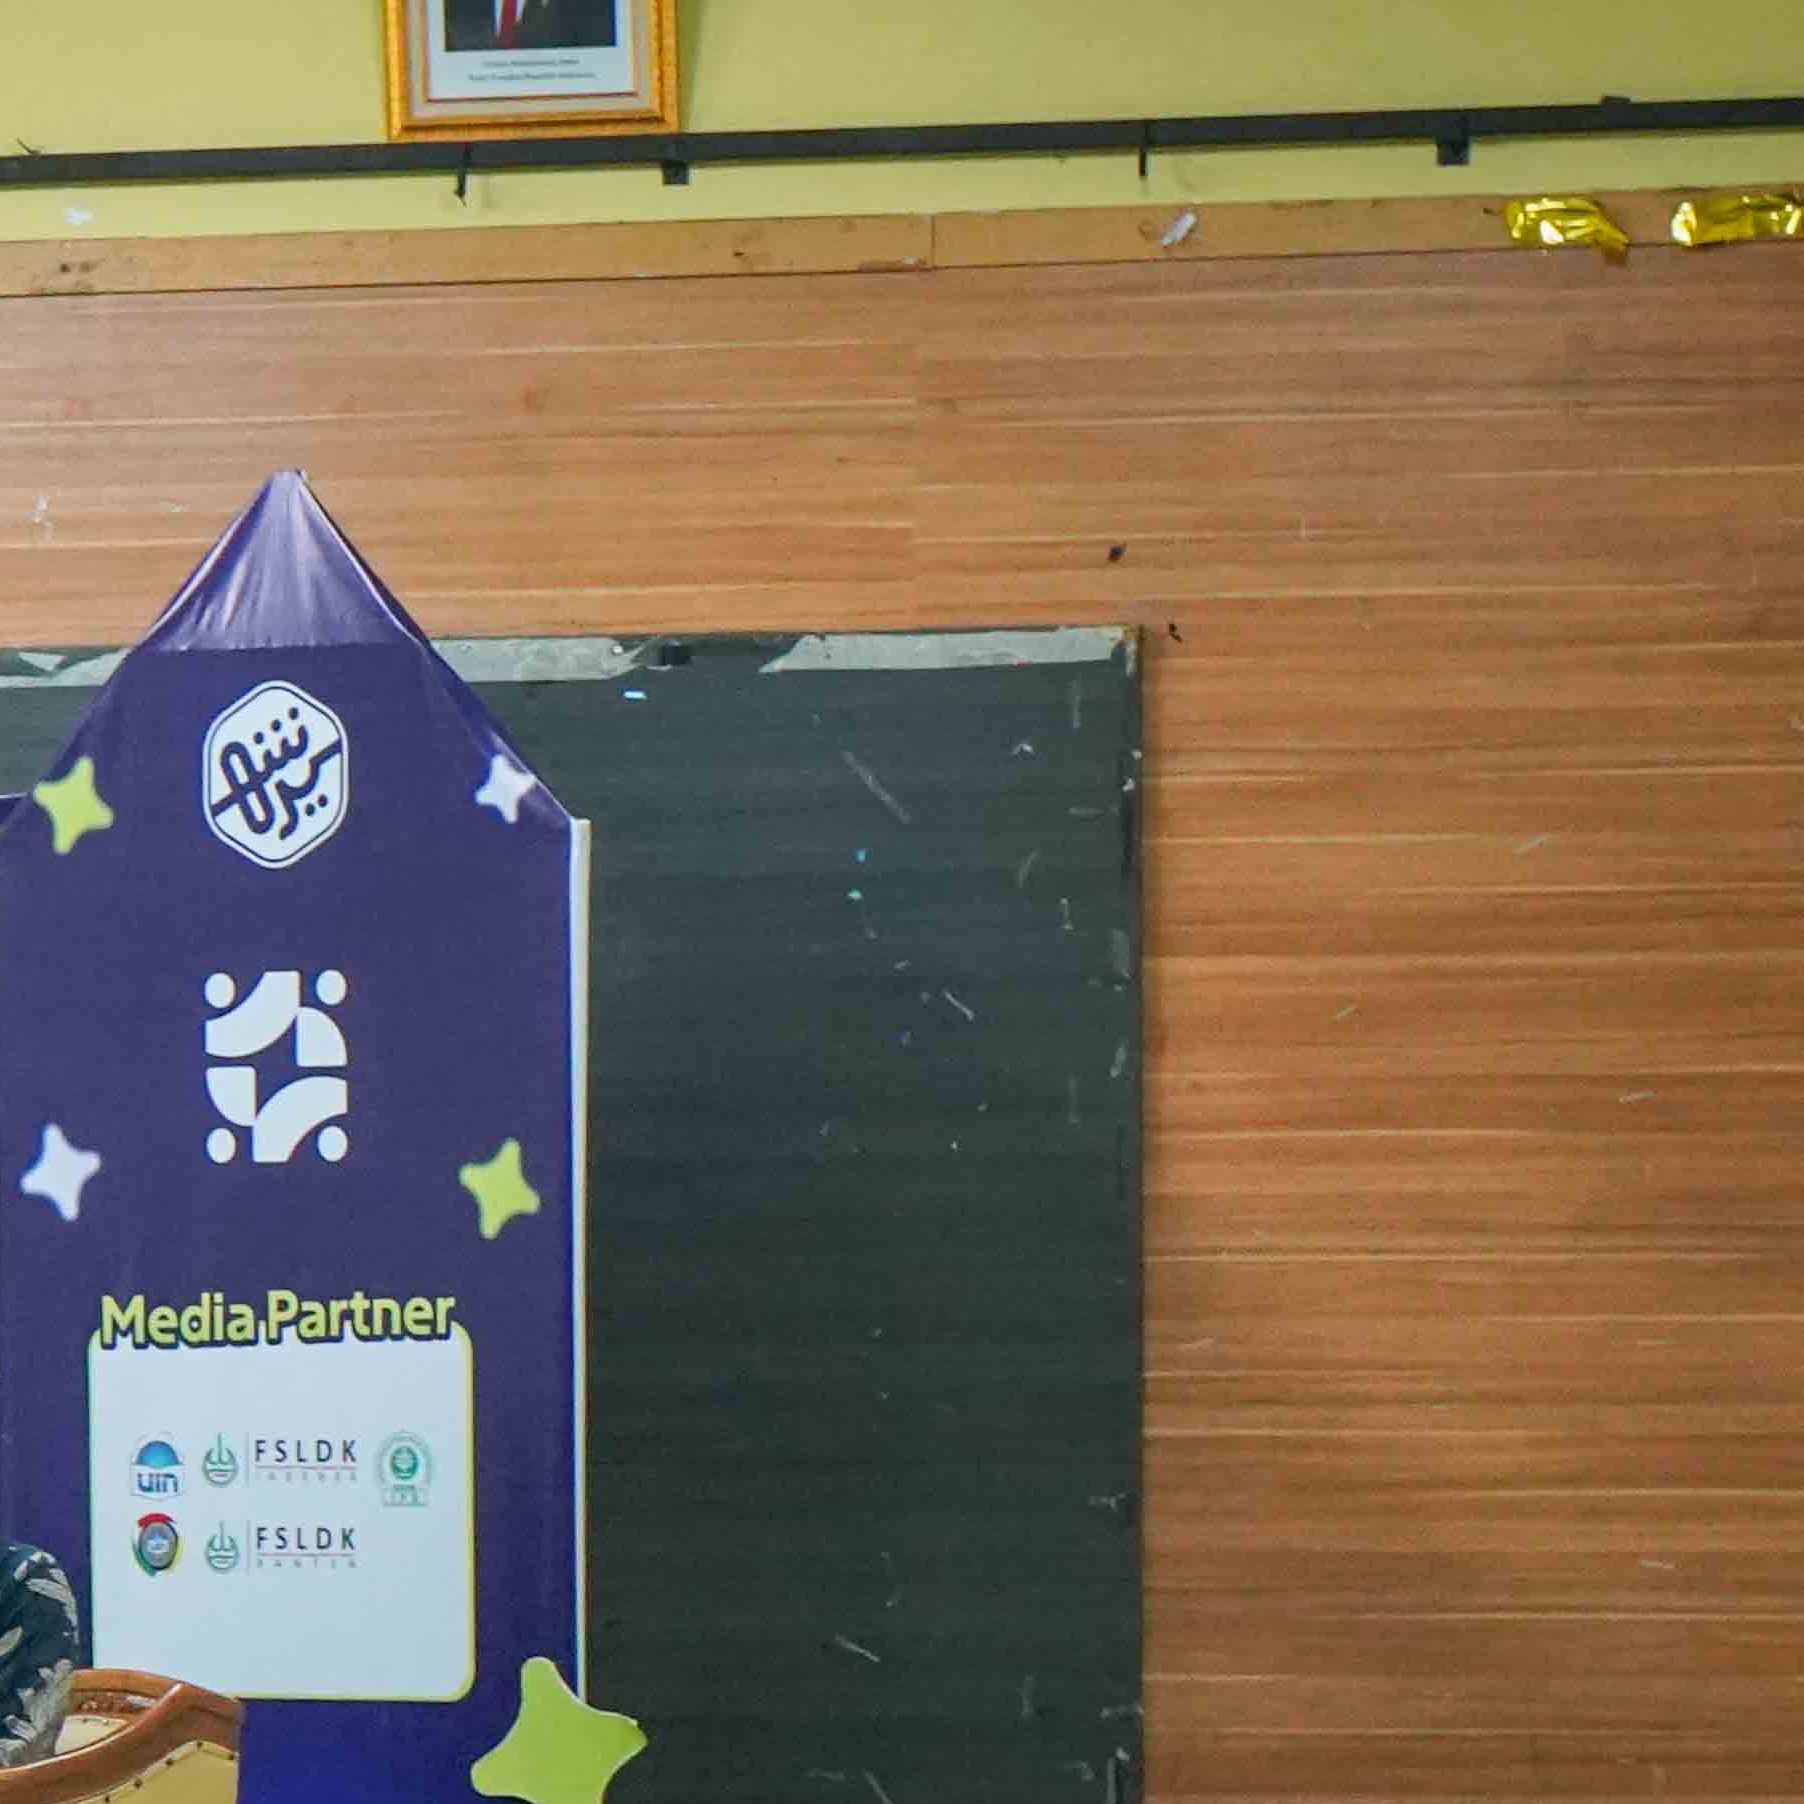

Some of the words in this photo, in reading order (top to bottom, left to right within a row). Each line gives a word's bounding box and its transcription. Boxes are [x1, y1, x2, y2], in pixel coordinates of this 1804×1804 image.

[100, 1292, 256, 1346] Media
[266, 1289, 456, 1340] Partner
[254, 1439, 357, 1462] FSLDK
[256, 1526, 356, 1550] FSLDK
